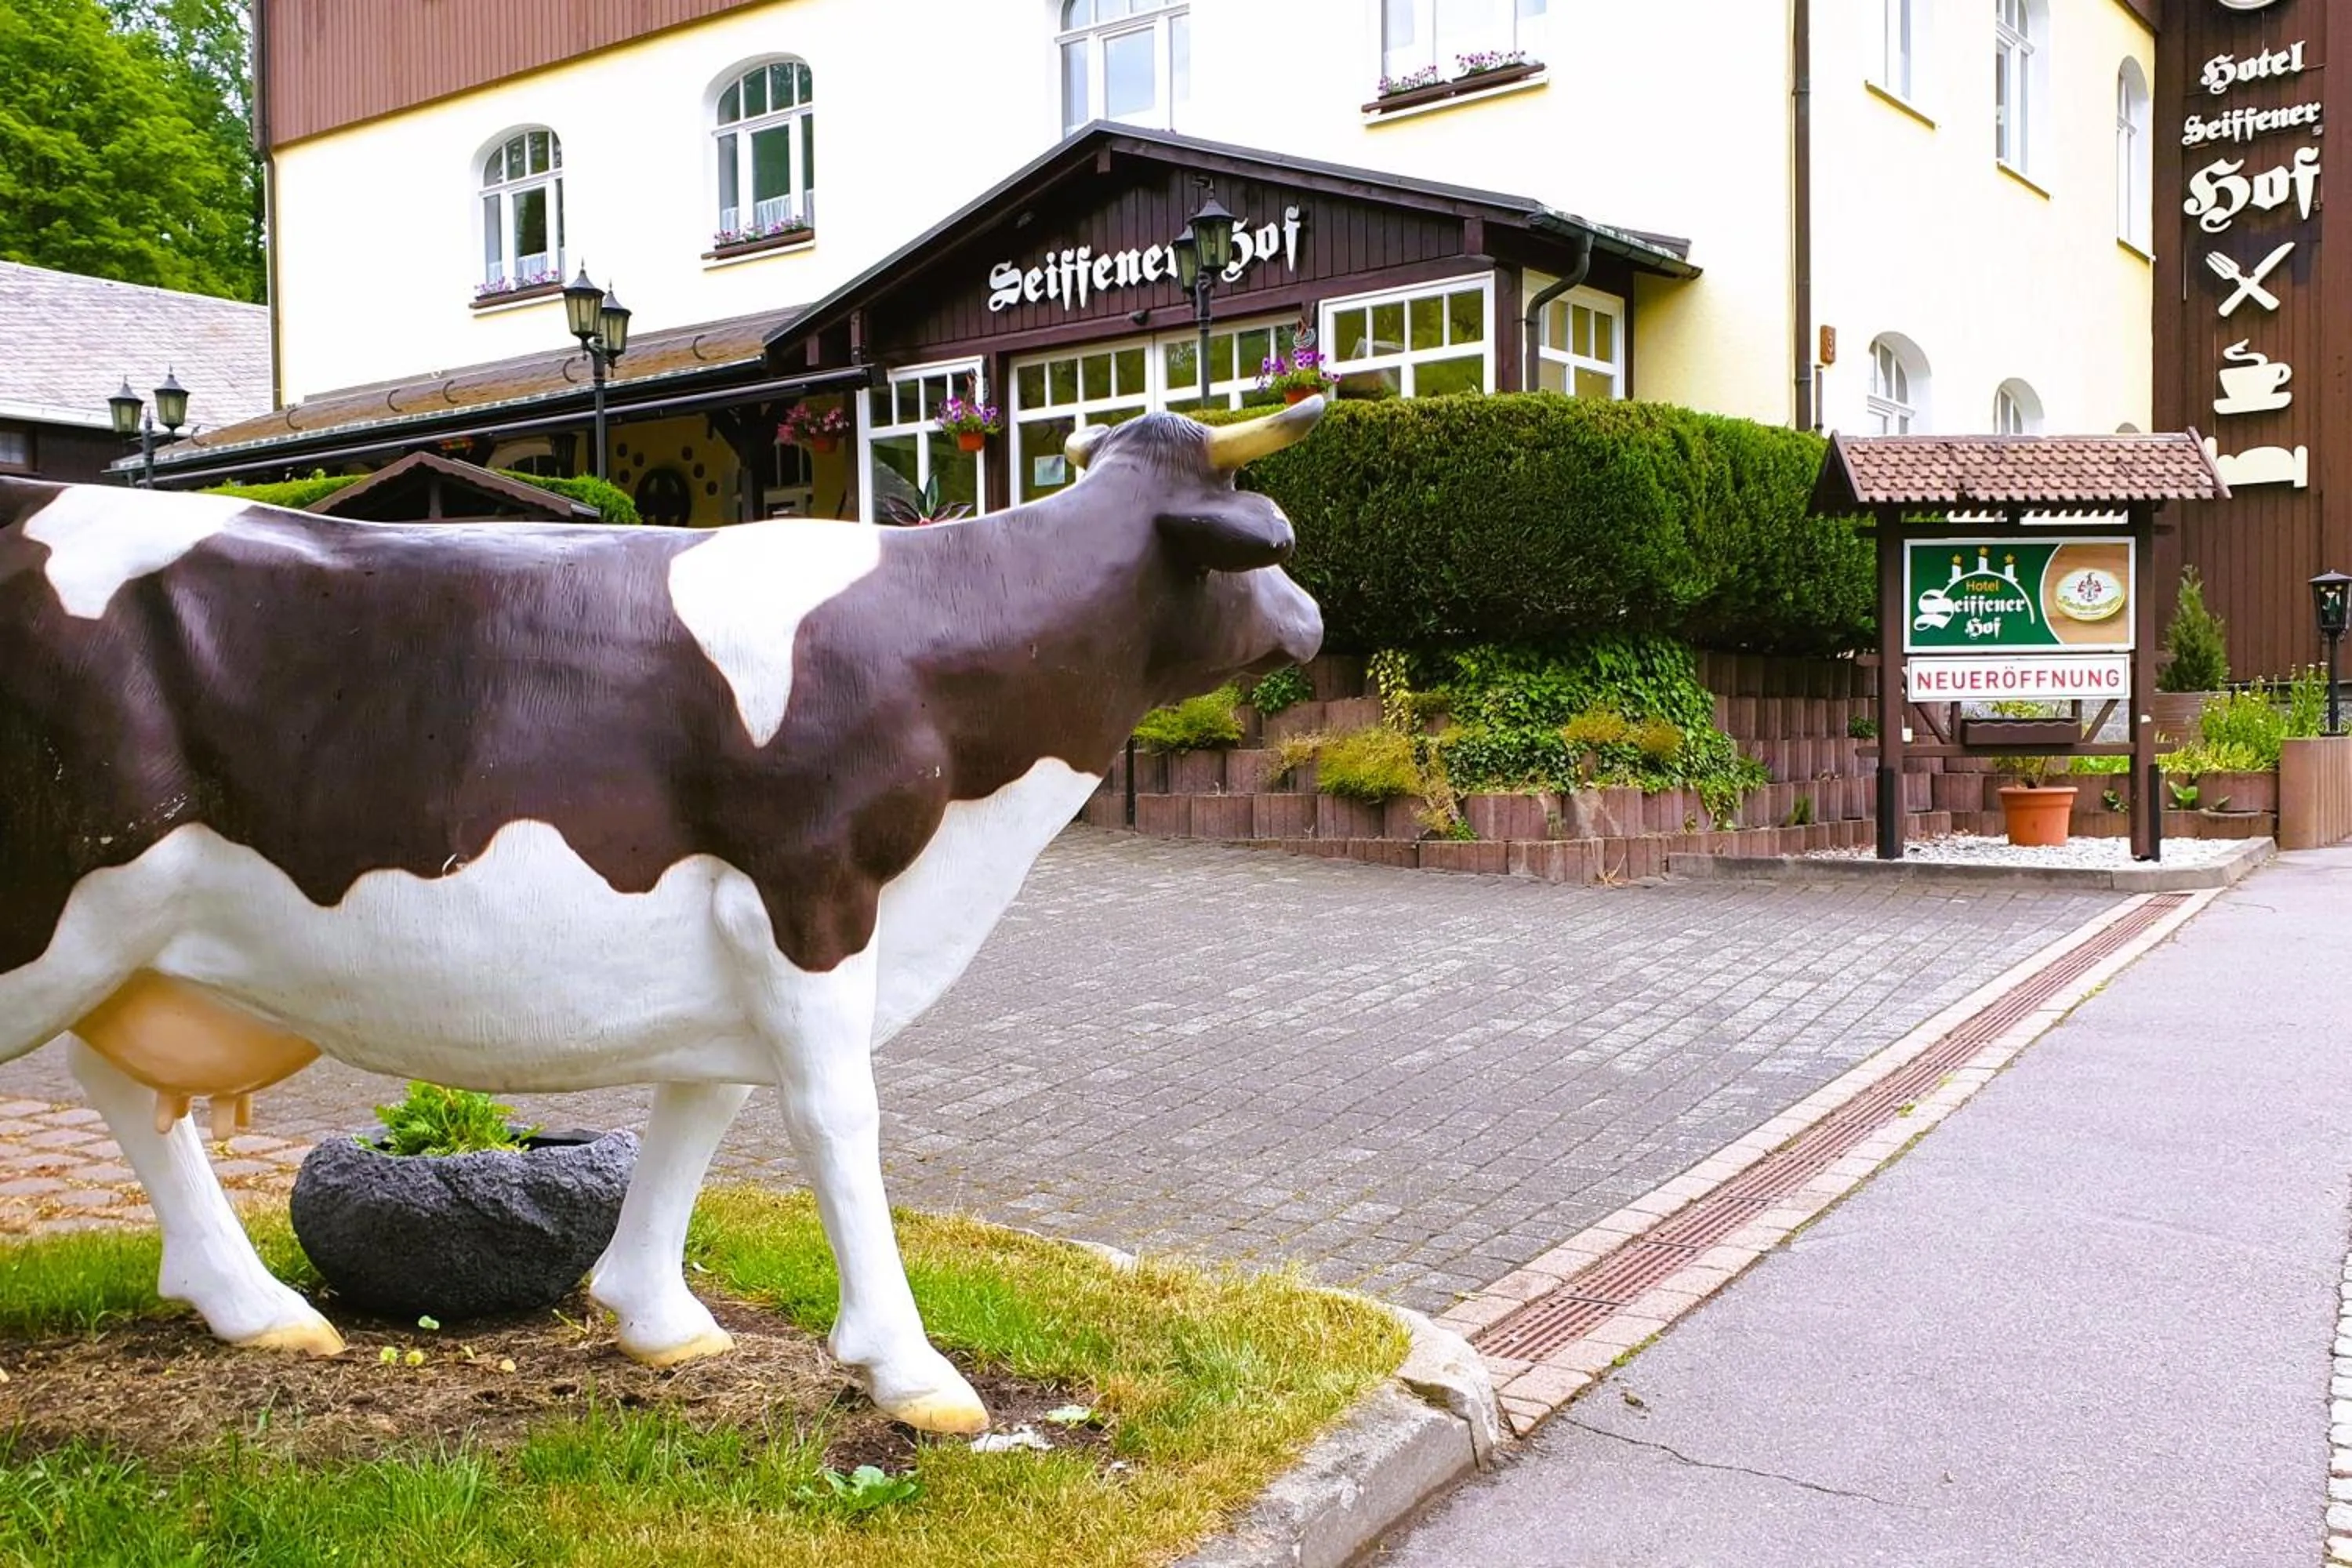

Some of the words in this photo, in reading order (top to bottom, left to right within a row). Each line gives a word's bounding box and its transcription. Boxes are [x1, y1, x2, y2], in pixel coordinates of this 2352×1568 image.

[2200, 40, 2306, 95] Hotel
[2181, 102, 2321, 146] Seiffener
[2183, 147, 2321, 233] Hof
[1966, 580, 1999, 592] Hotel
[1914, 589, 2025, 631] Seiffener
[1965, 616, 2001, 640] Hof
[1917, 666, 2120, 690] NEUERÖFFNUNG
